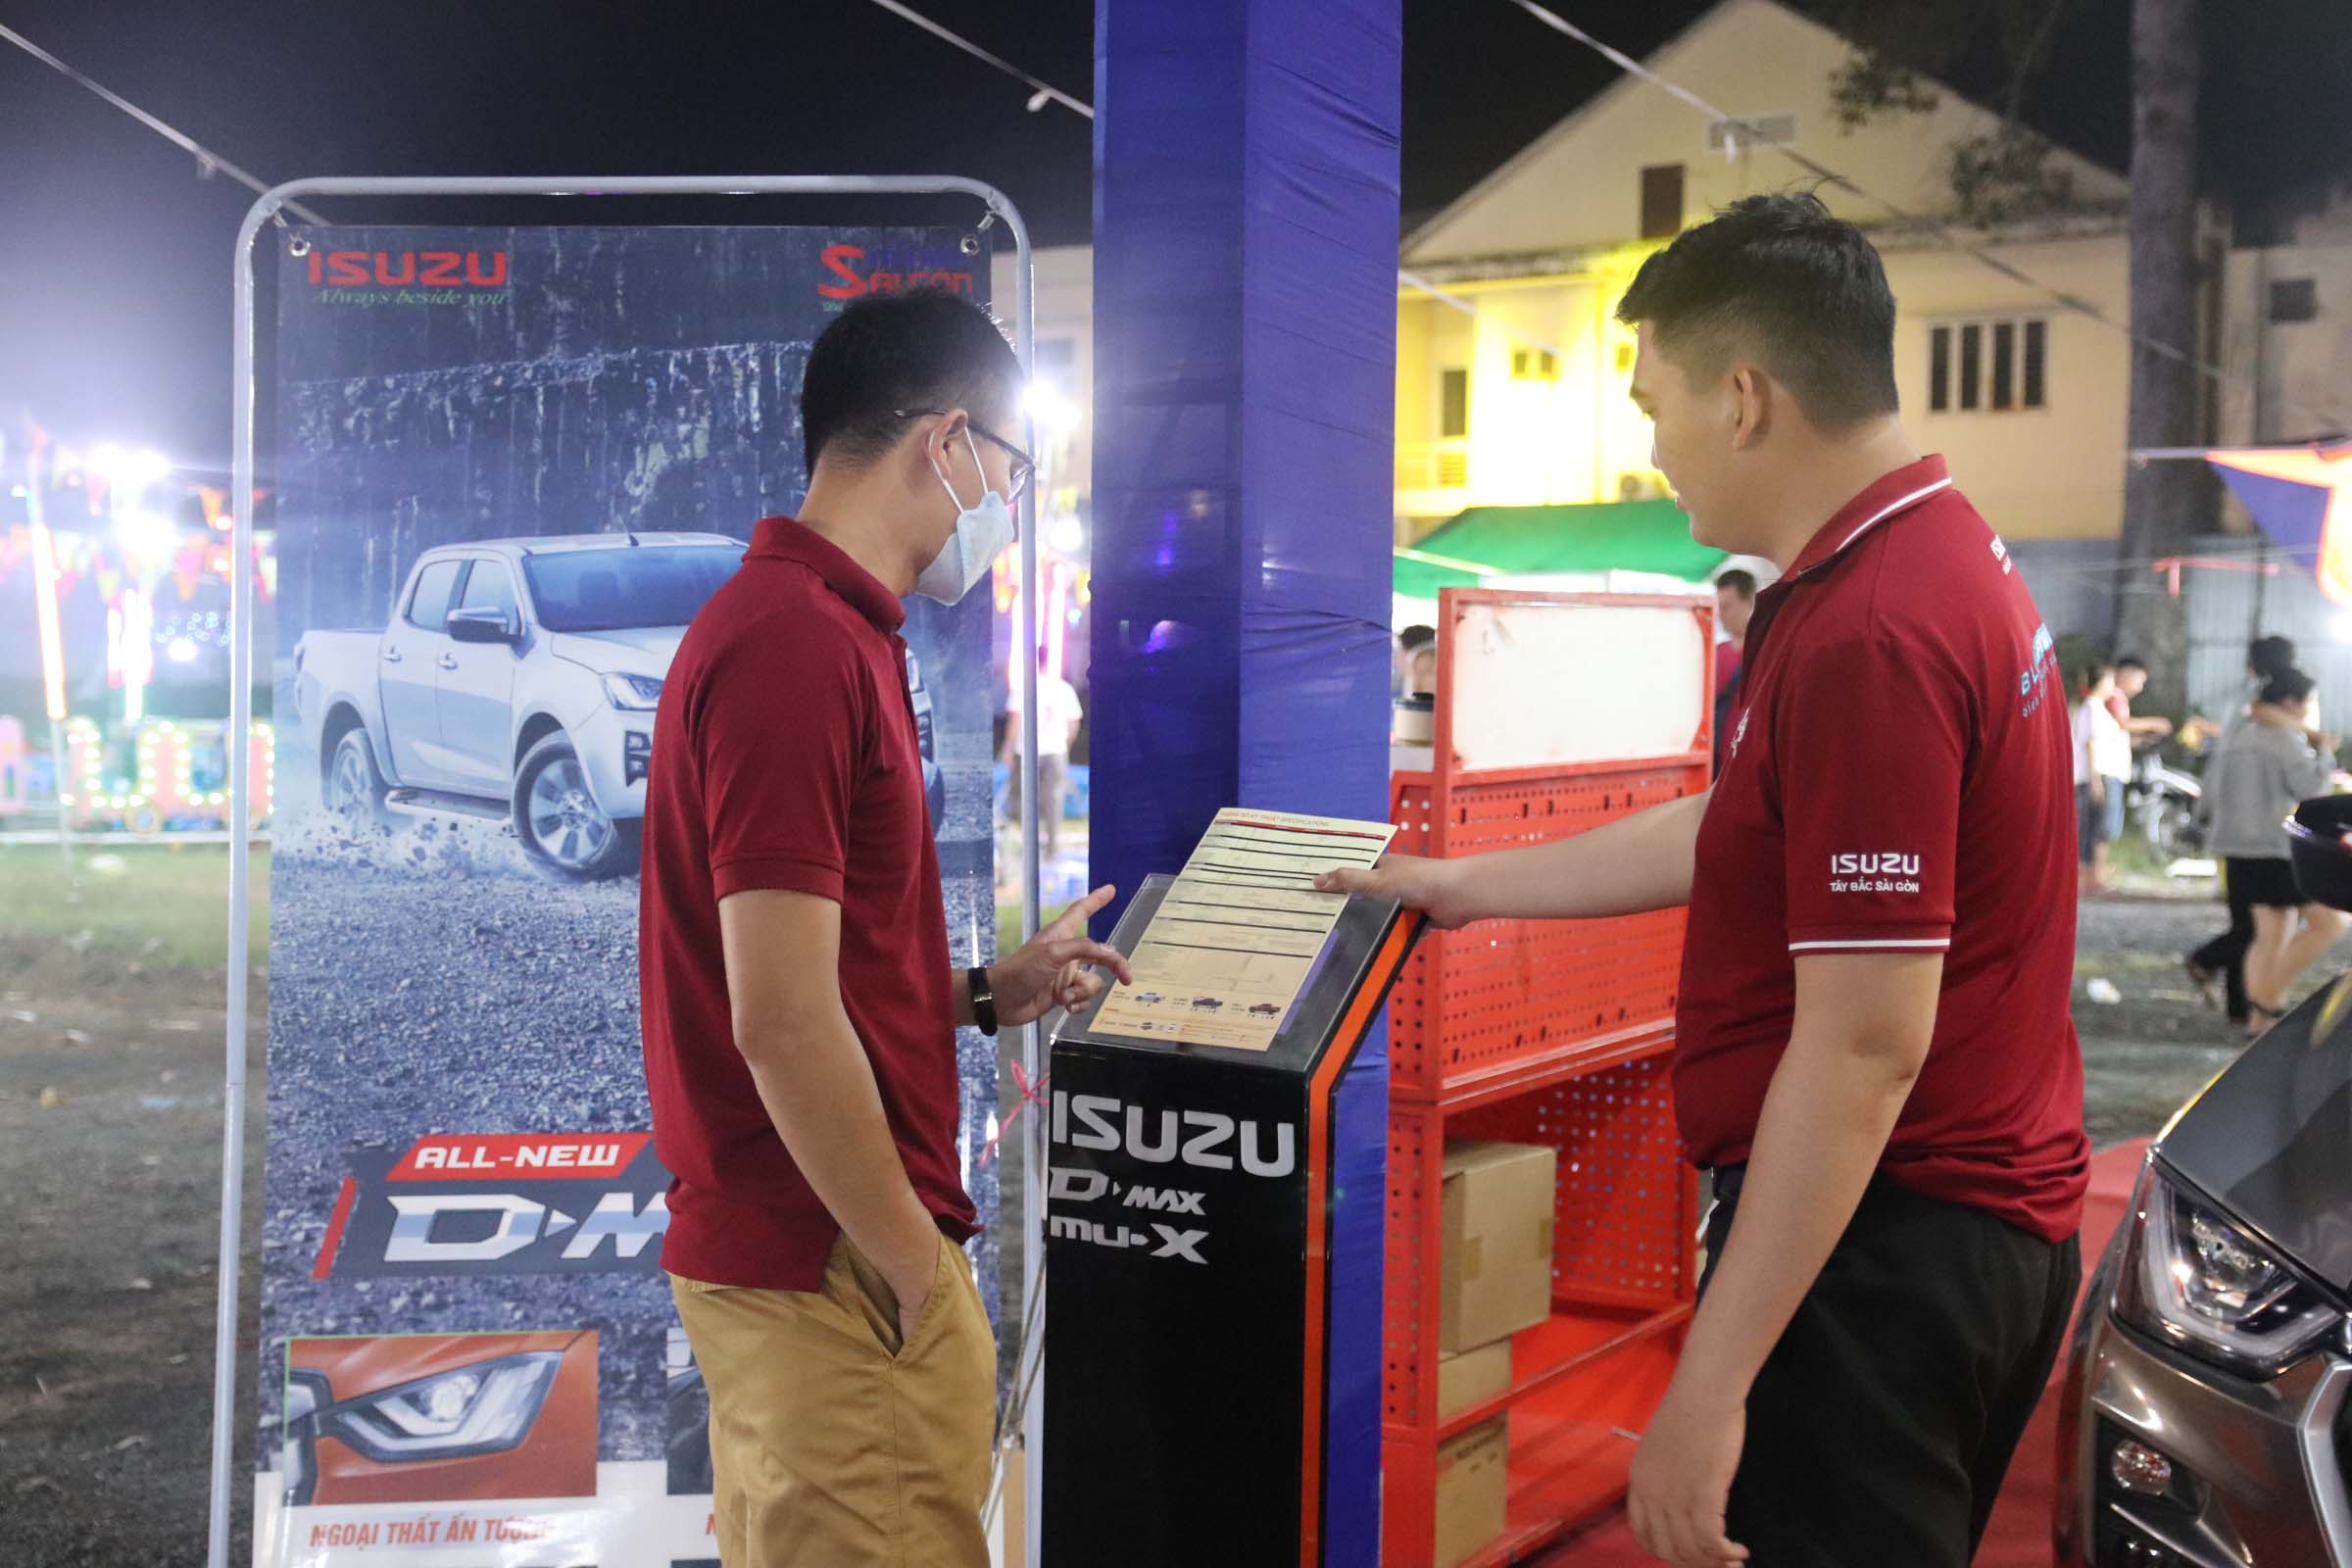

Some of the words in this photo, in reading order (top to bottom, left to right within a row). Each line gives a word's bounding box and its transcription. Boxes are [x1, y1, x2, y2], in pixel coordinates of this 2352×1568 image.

[309, 251, 508, 286] ISUZU
[314, 290, 389, 309] Always
[395, 290, 462, 306] beside
[464, 293, 506, 309] you
[1831, 853, 1920, 875] ISUZU
[1830, 879, 1848, 893] TÂY
[1849, 876, 1873, 892] BẮC
[1875, 878, 1893, 892] SÀI
[1895, 879, 1920, 893] GÒN
[1052, 1090, 1296, 1178] ISUZU
[414, 1145, 621, 1169] ALL-NEW
[309, 1522, 380, 1550] NGOẠI
[387, 1512, 441, 1544] THẤT
[445, 1511, 479, 1543] ẤN
